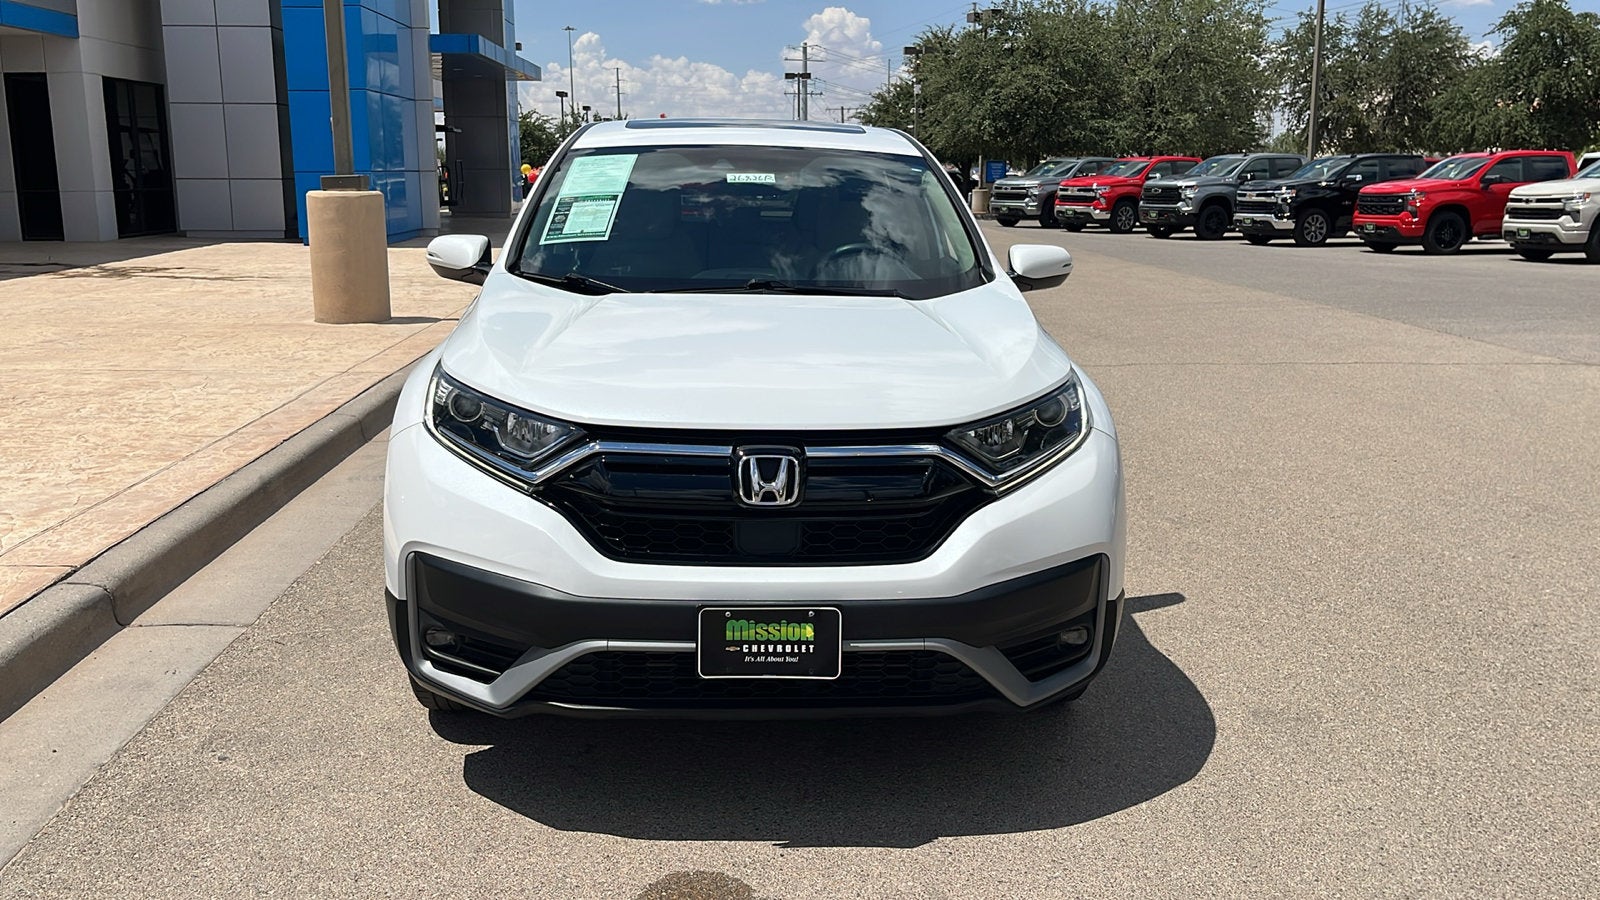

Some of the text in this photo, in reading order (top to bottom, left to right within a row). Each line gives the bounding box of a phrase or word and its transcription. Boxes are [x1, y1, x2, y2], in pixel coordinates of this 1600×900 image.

[725, 619, 815, 641] Mission
[742, 644, 815, 653] CHEVROLET
[744, 655, 755, 663] It's
[785, 655, 799, 663] You!
